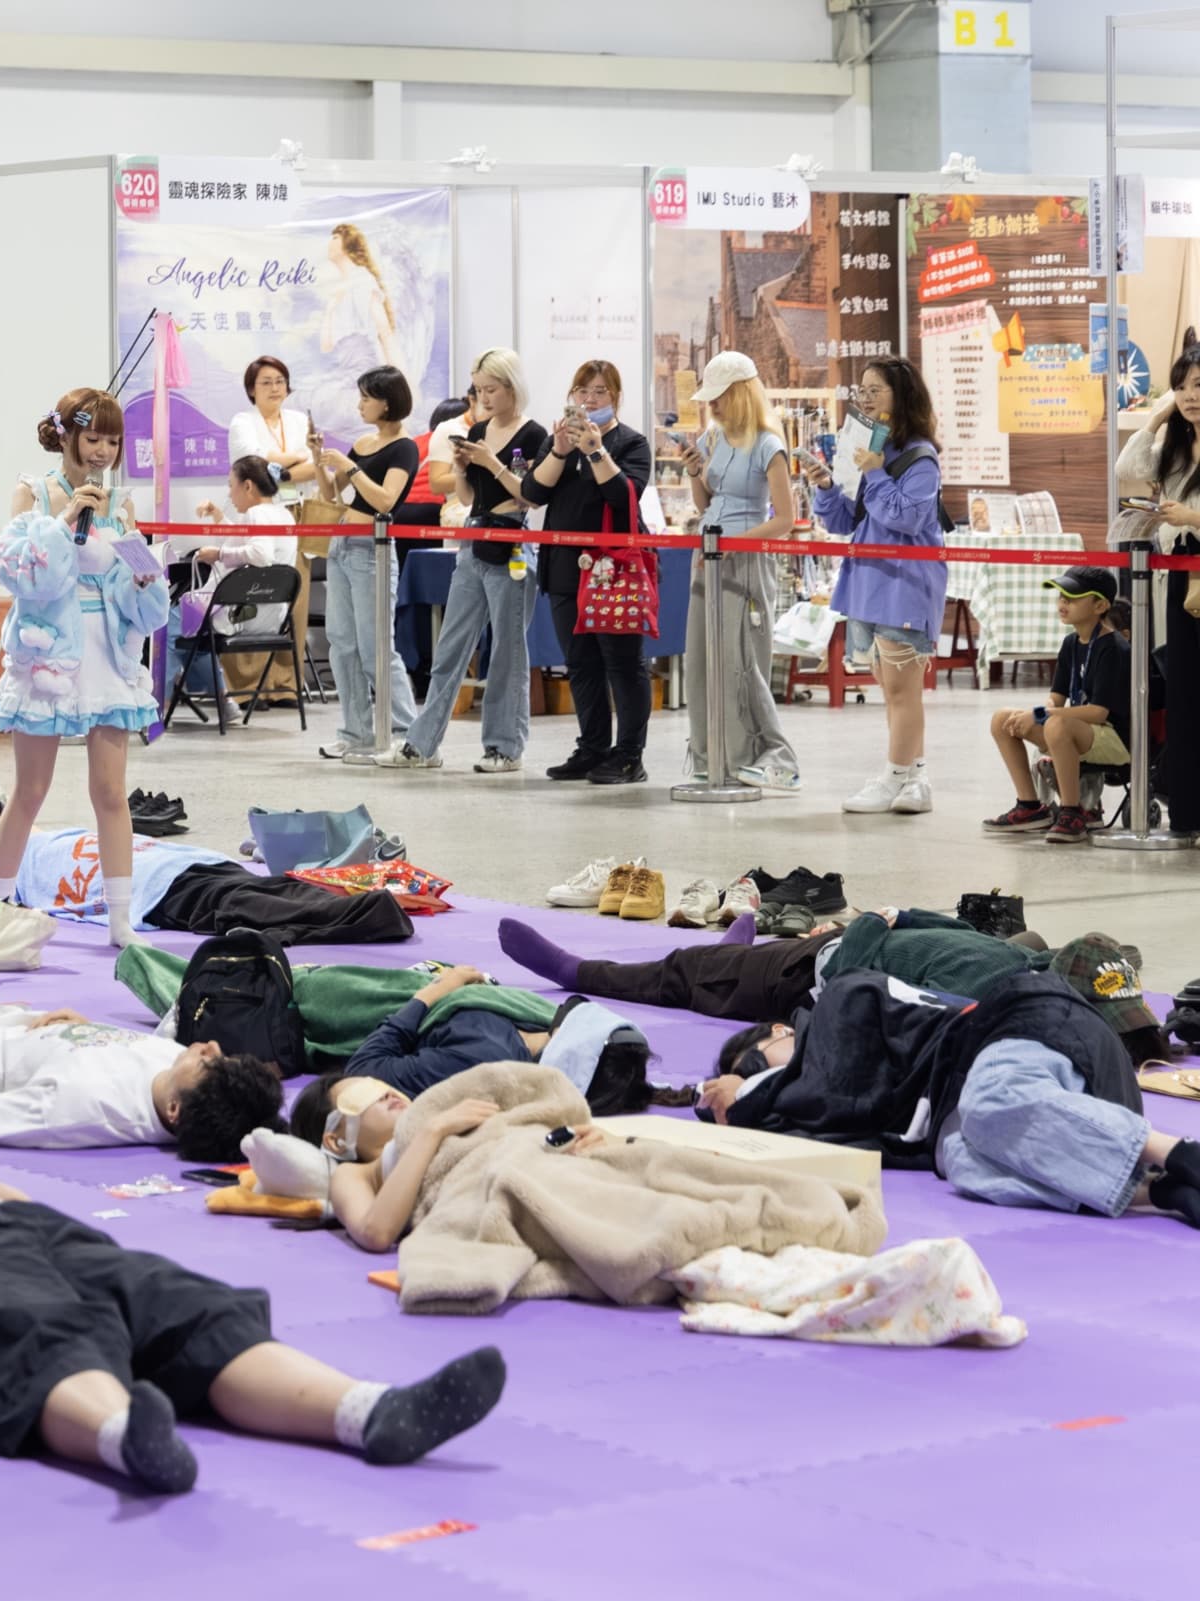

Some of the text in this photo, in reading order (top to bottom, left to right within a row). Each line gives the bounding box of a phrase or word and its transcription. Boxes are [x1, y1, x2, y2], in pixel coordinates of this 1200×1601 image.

[121, 173, 156, 196] 620
[168, 181, 248, 200] 靈魂探險家
[654, 183, 684, 204] 619
[723, 192, 765, 206] Studio
[969, 213, 1040, 238] 活動辦法
[841, 253, 891, 270] 手作選品
[147, 257, 317, 299] Angelic Reiki
[840, 296, 888, 315] 企業包班
